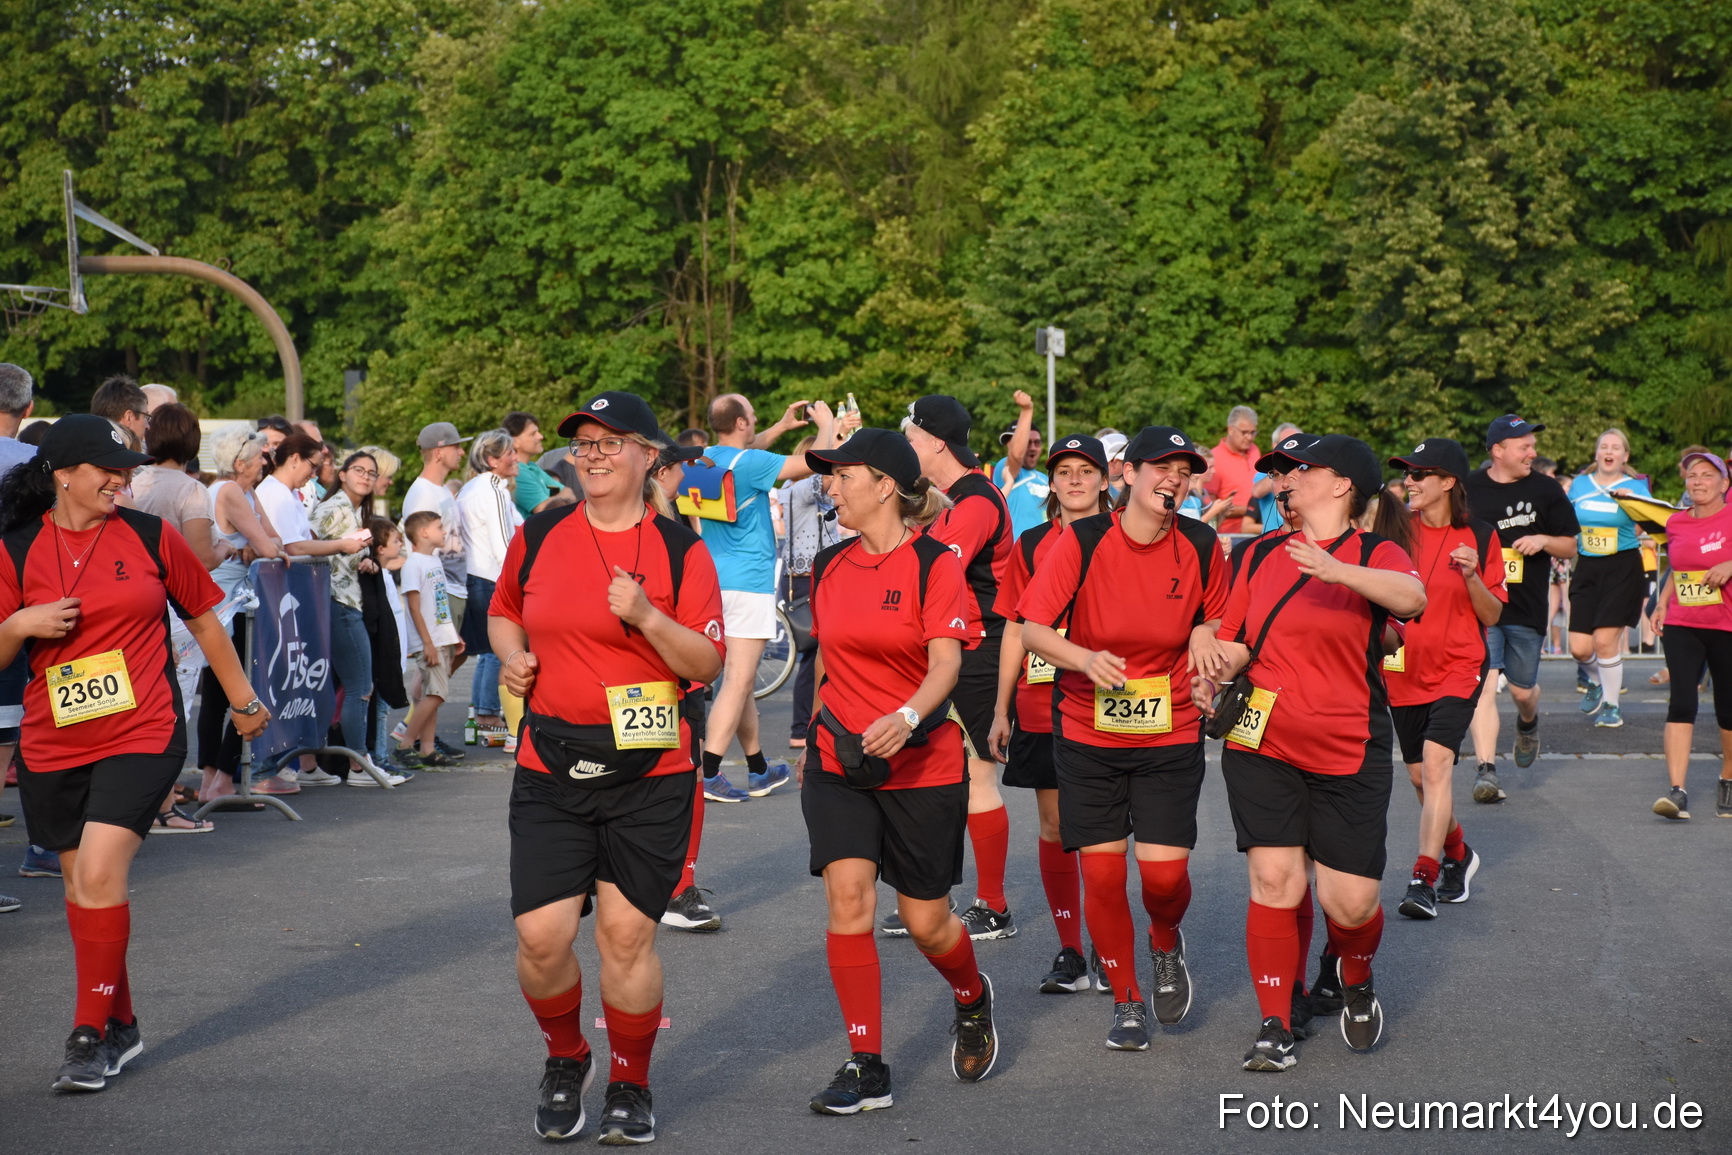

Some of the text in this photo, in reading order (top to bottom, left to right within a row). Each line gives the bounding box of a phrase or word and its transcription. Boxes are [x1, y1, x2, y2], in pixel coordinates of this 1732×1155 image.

[1587, 536, 1607, 547] 831
[114, 560, 126, 576] 2
[1171, 577, 1180, 593] 7
[883, 589, 901, 605] 10
[57, 674, 119, 708] 2360
[67, 702, 96, 713] Seemeier
[97, 697, 116, 706] Sonja
[1104, 697, 1161, 718] 2347
[621, 706, 673, 730] 2351
[575, 759, 606, 774] NIKE
